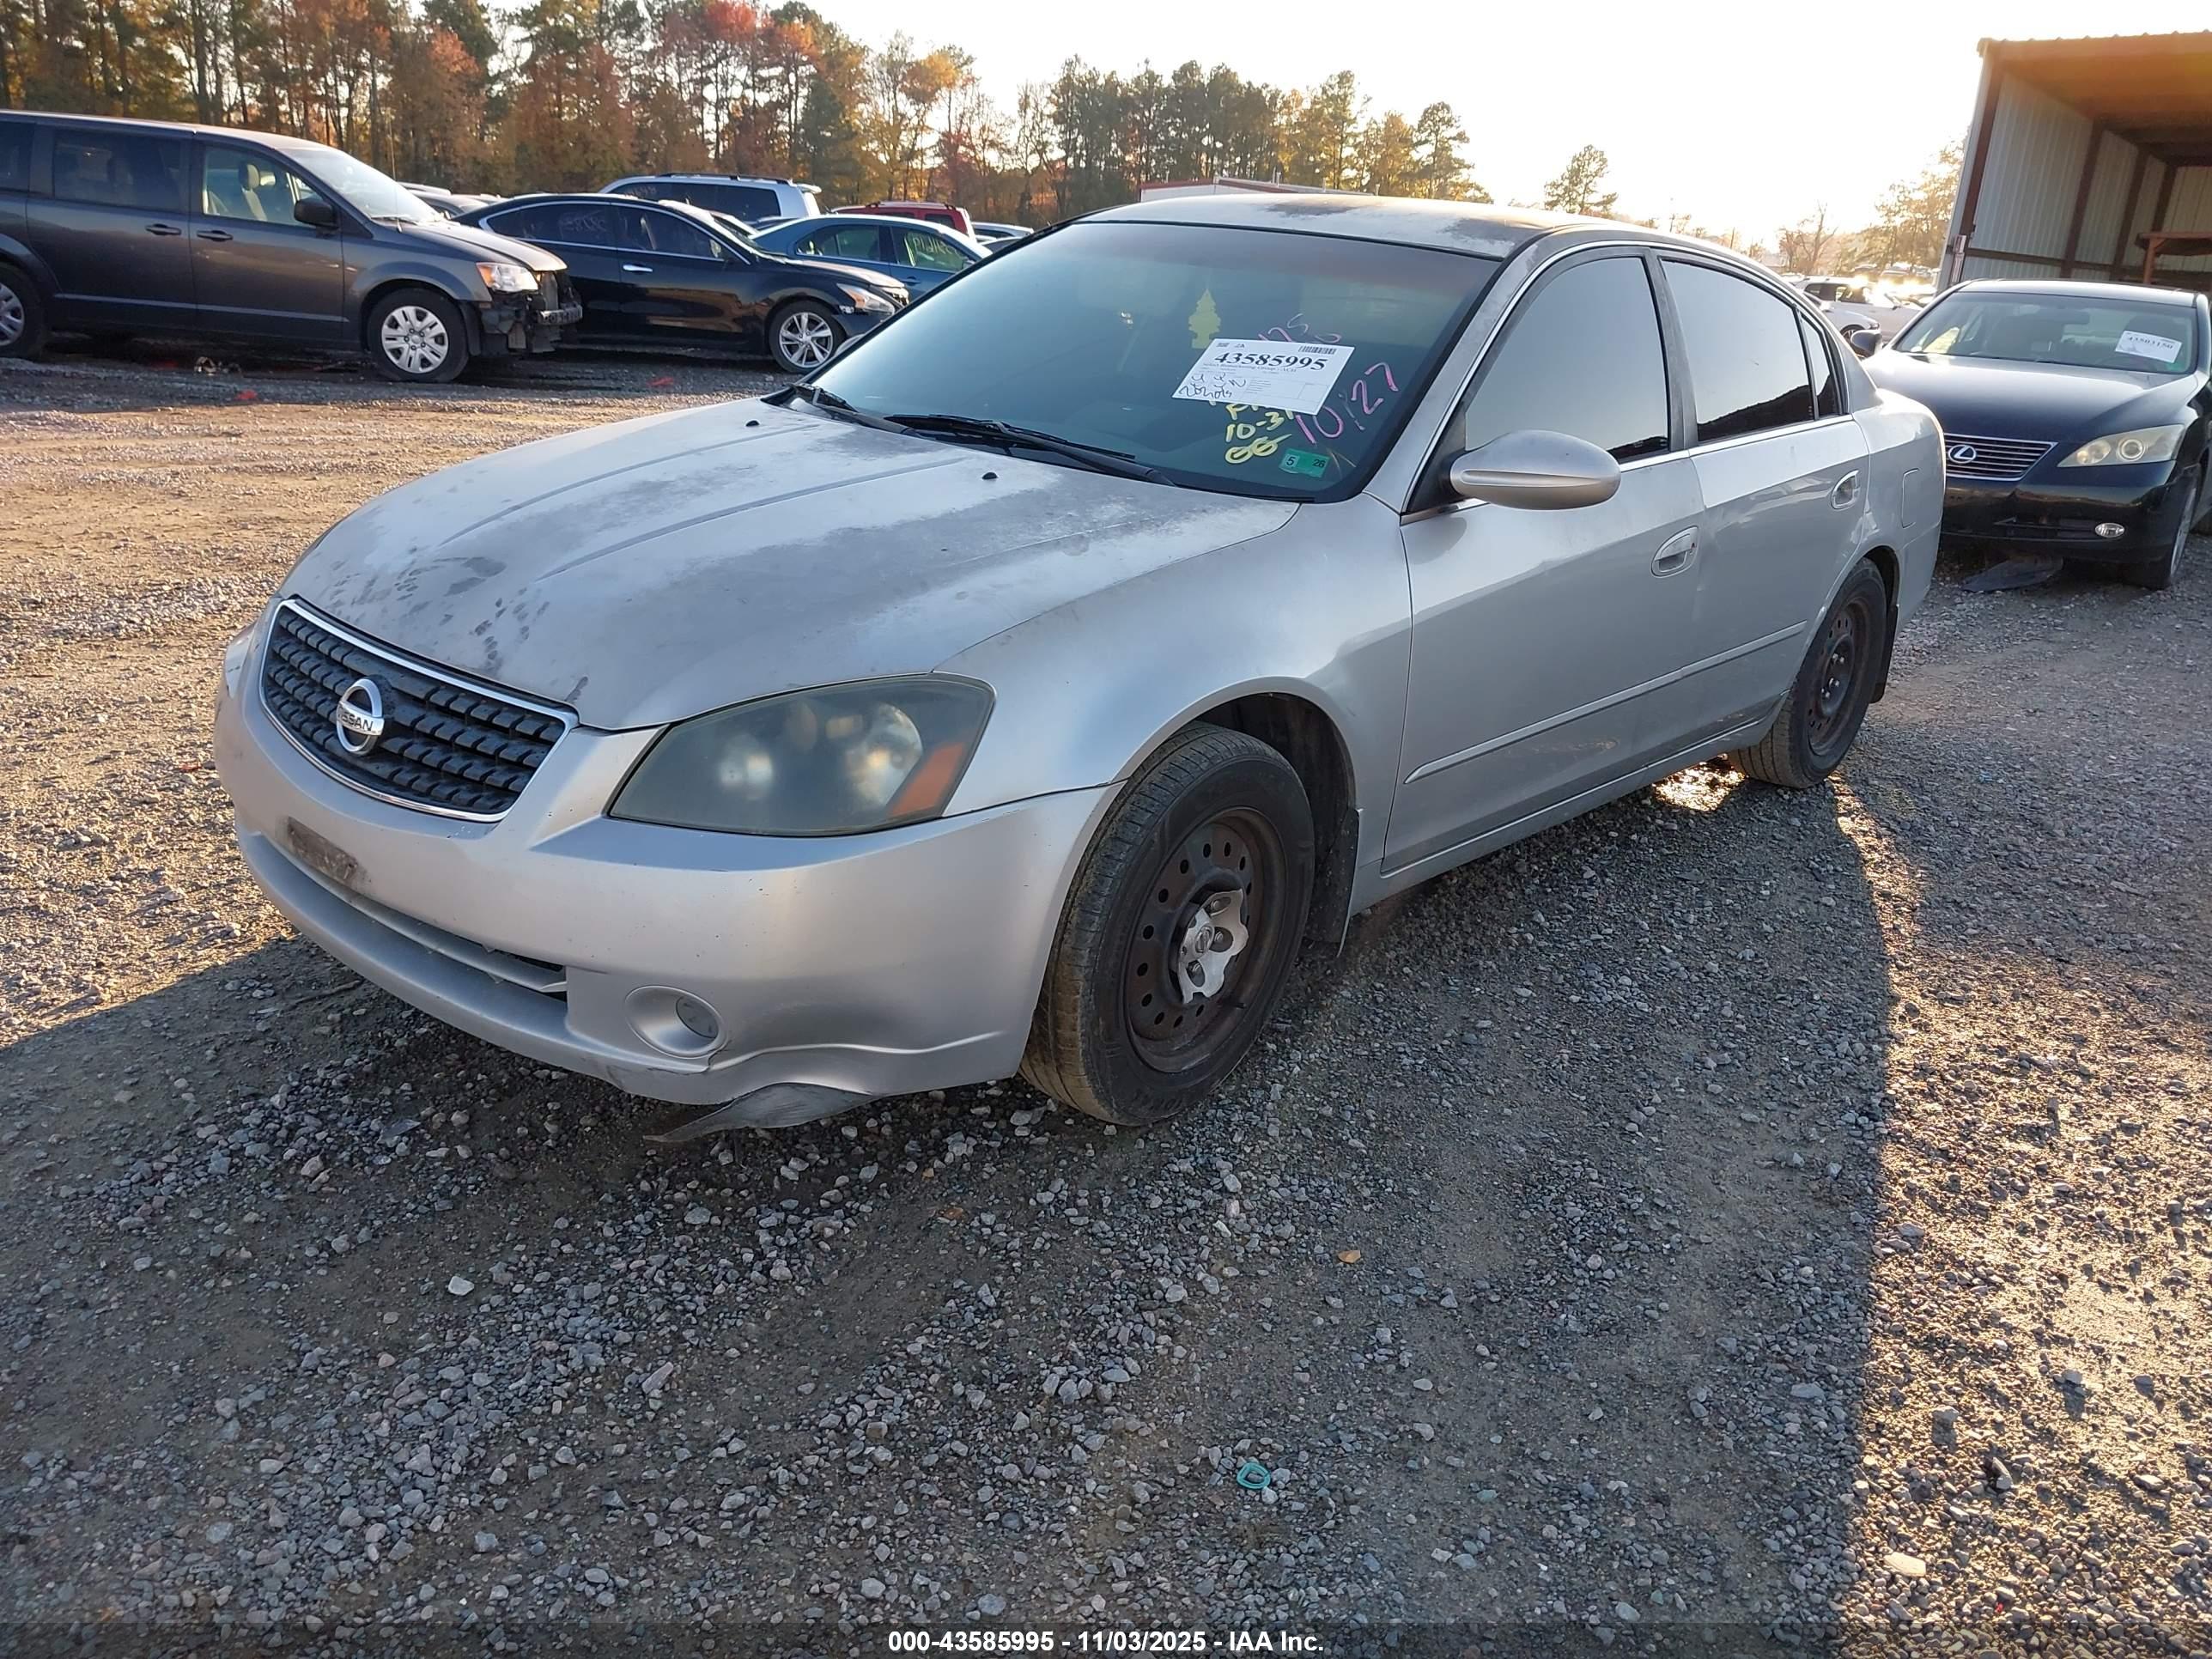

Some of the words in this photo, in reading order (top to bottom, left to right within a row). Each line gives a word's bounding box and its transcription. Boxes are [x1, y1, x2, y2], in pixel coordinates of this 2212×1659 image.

[1214, 352, 1328, 371] 43585995
[1286, 458, 1295, 466] 5
[1313, 459, 1326, 468] 26
